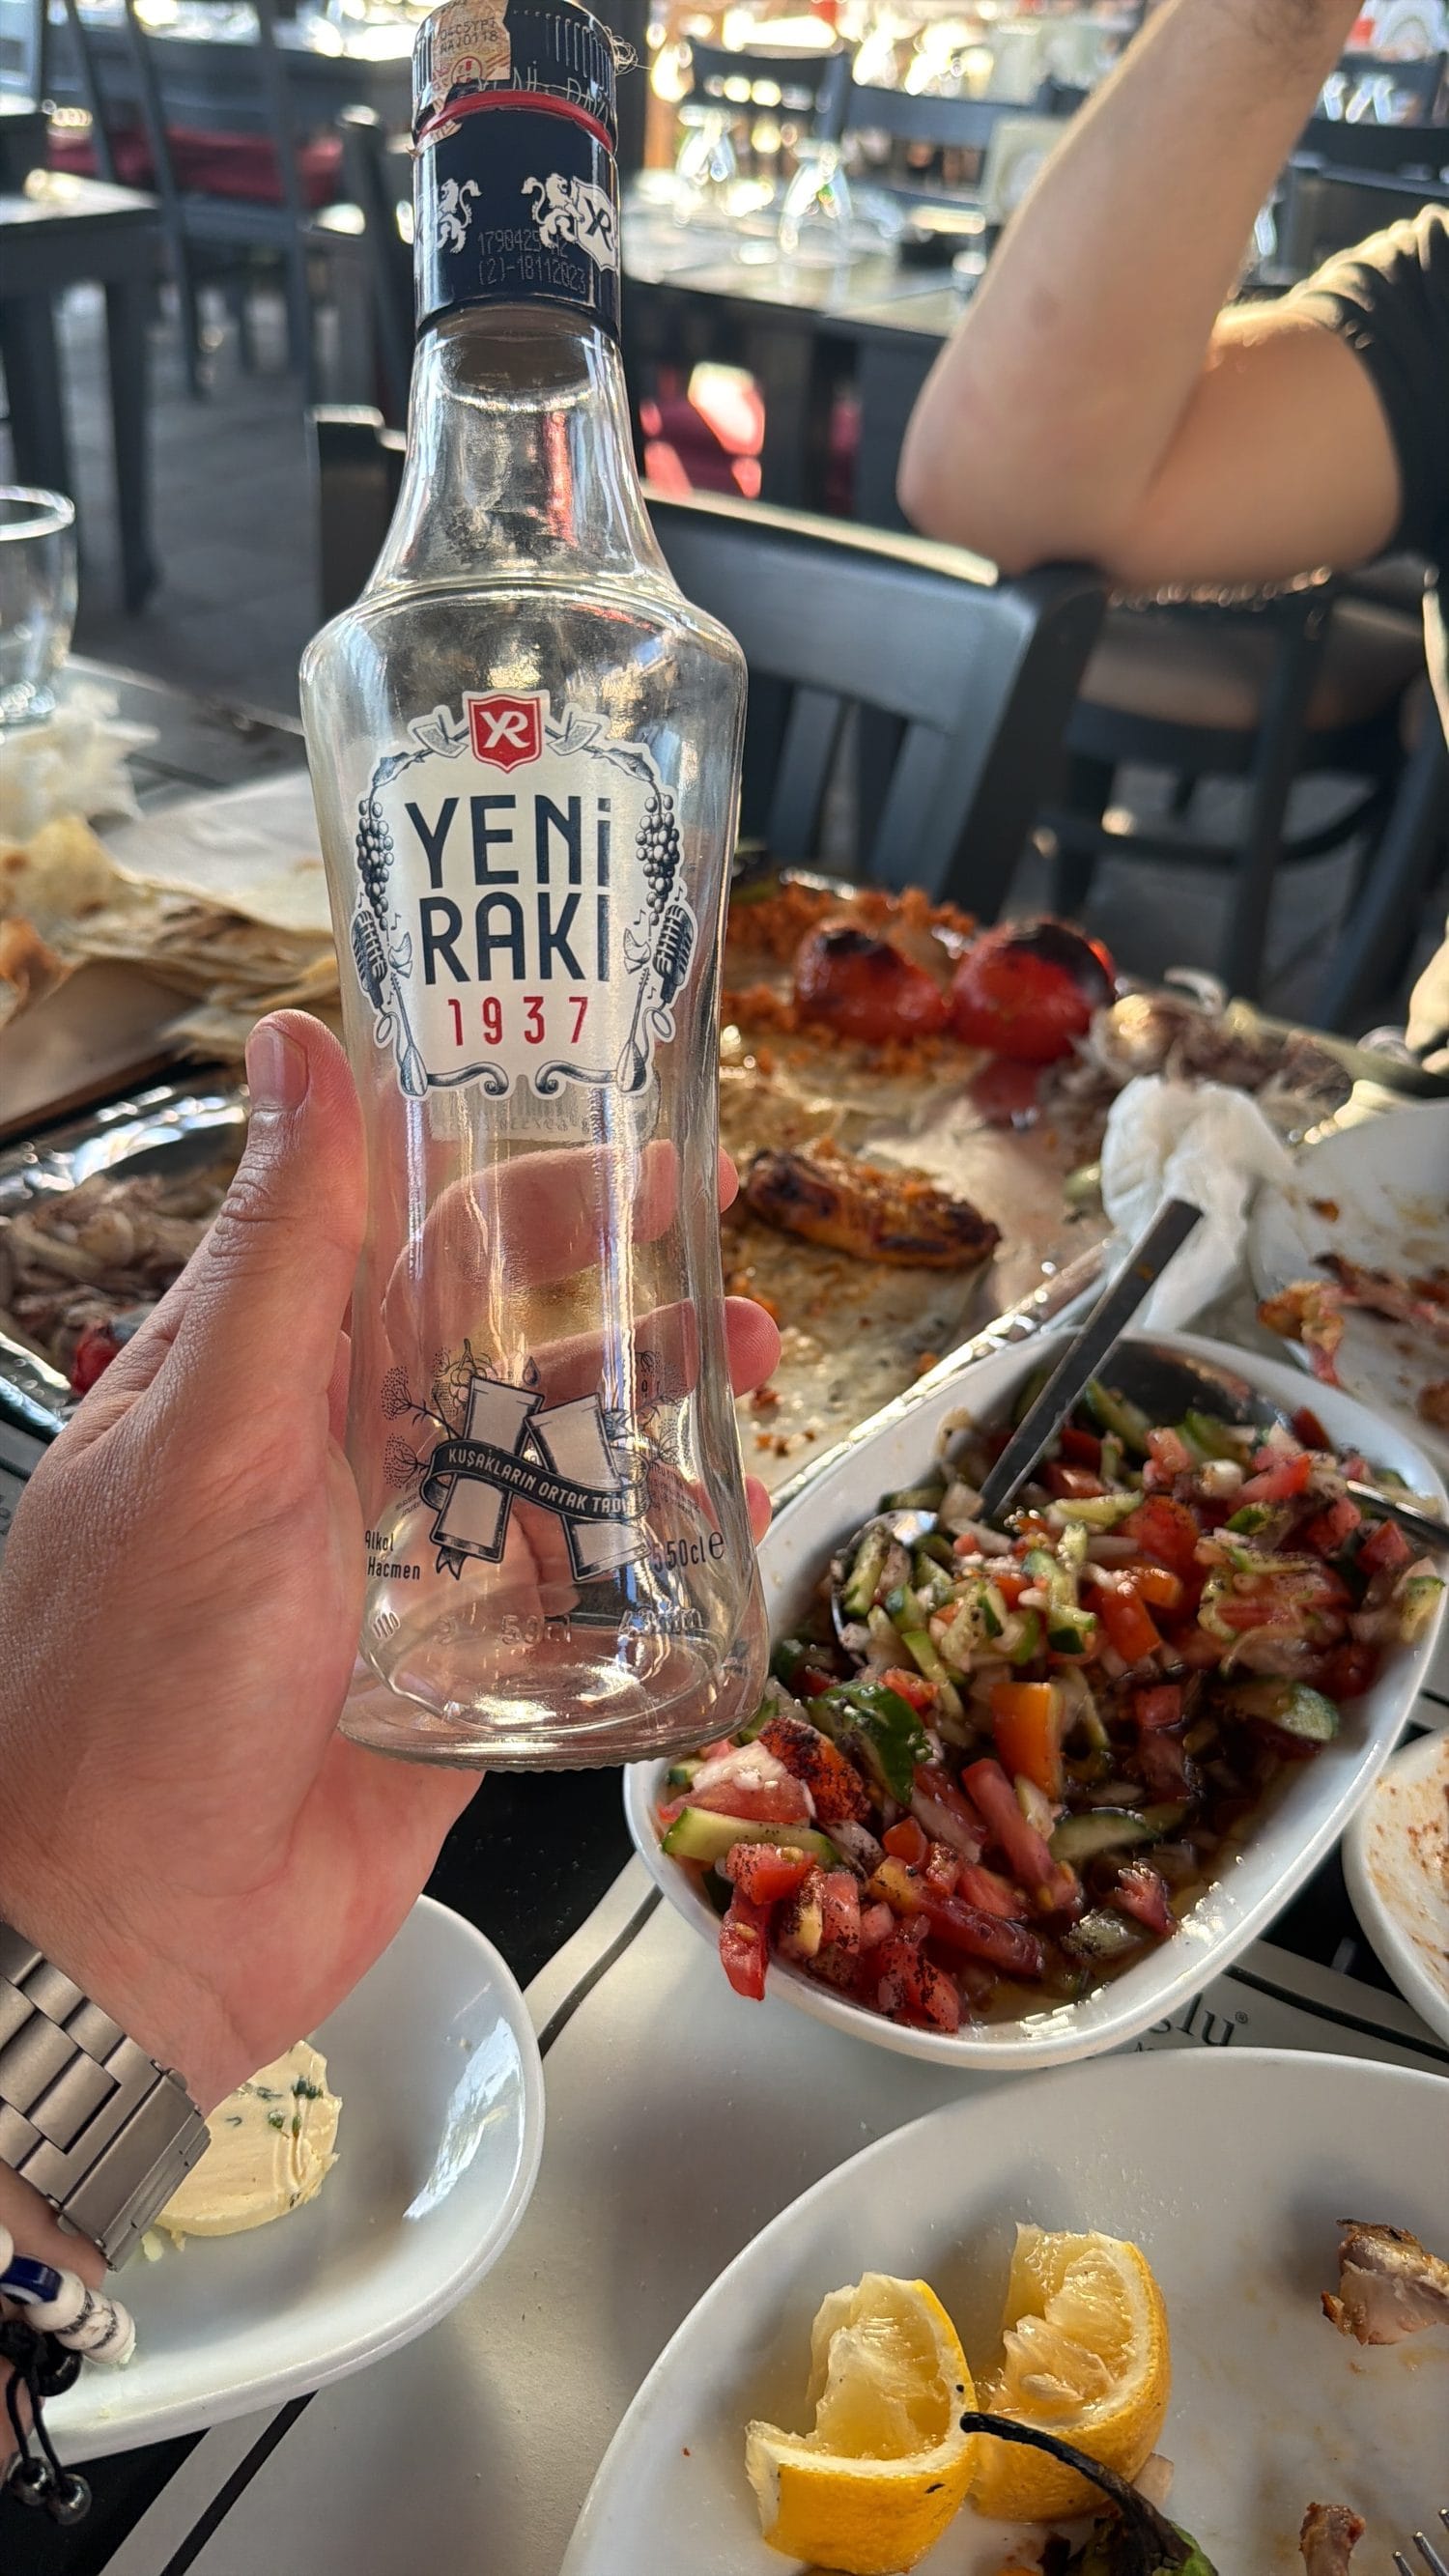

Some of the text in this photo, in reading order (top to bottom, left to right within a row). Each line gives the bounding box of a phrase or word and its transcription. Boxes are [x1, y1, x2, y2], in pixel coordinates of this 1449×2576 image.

[419, 891, 611, 985] RAKI
[447, 996, 589, 1046] 1937
[447, 1447, 537, 1491] KUŞAKLARIN
[537, 1481, 588, 1512] ORTAK
[364, 1529, 394, 1552] Alkol
[367, 1556, 421, 1580] Hacmen
